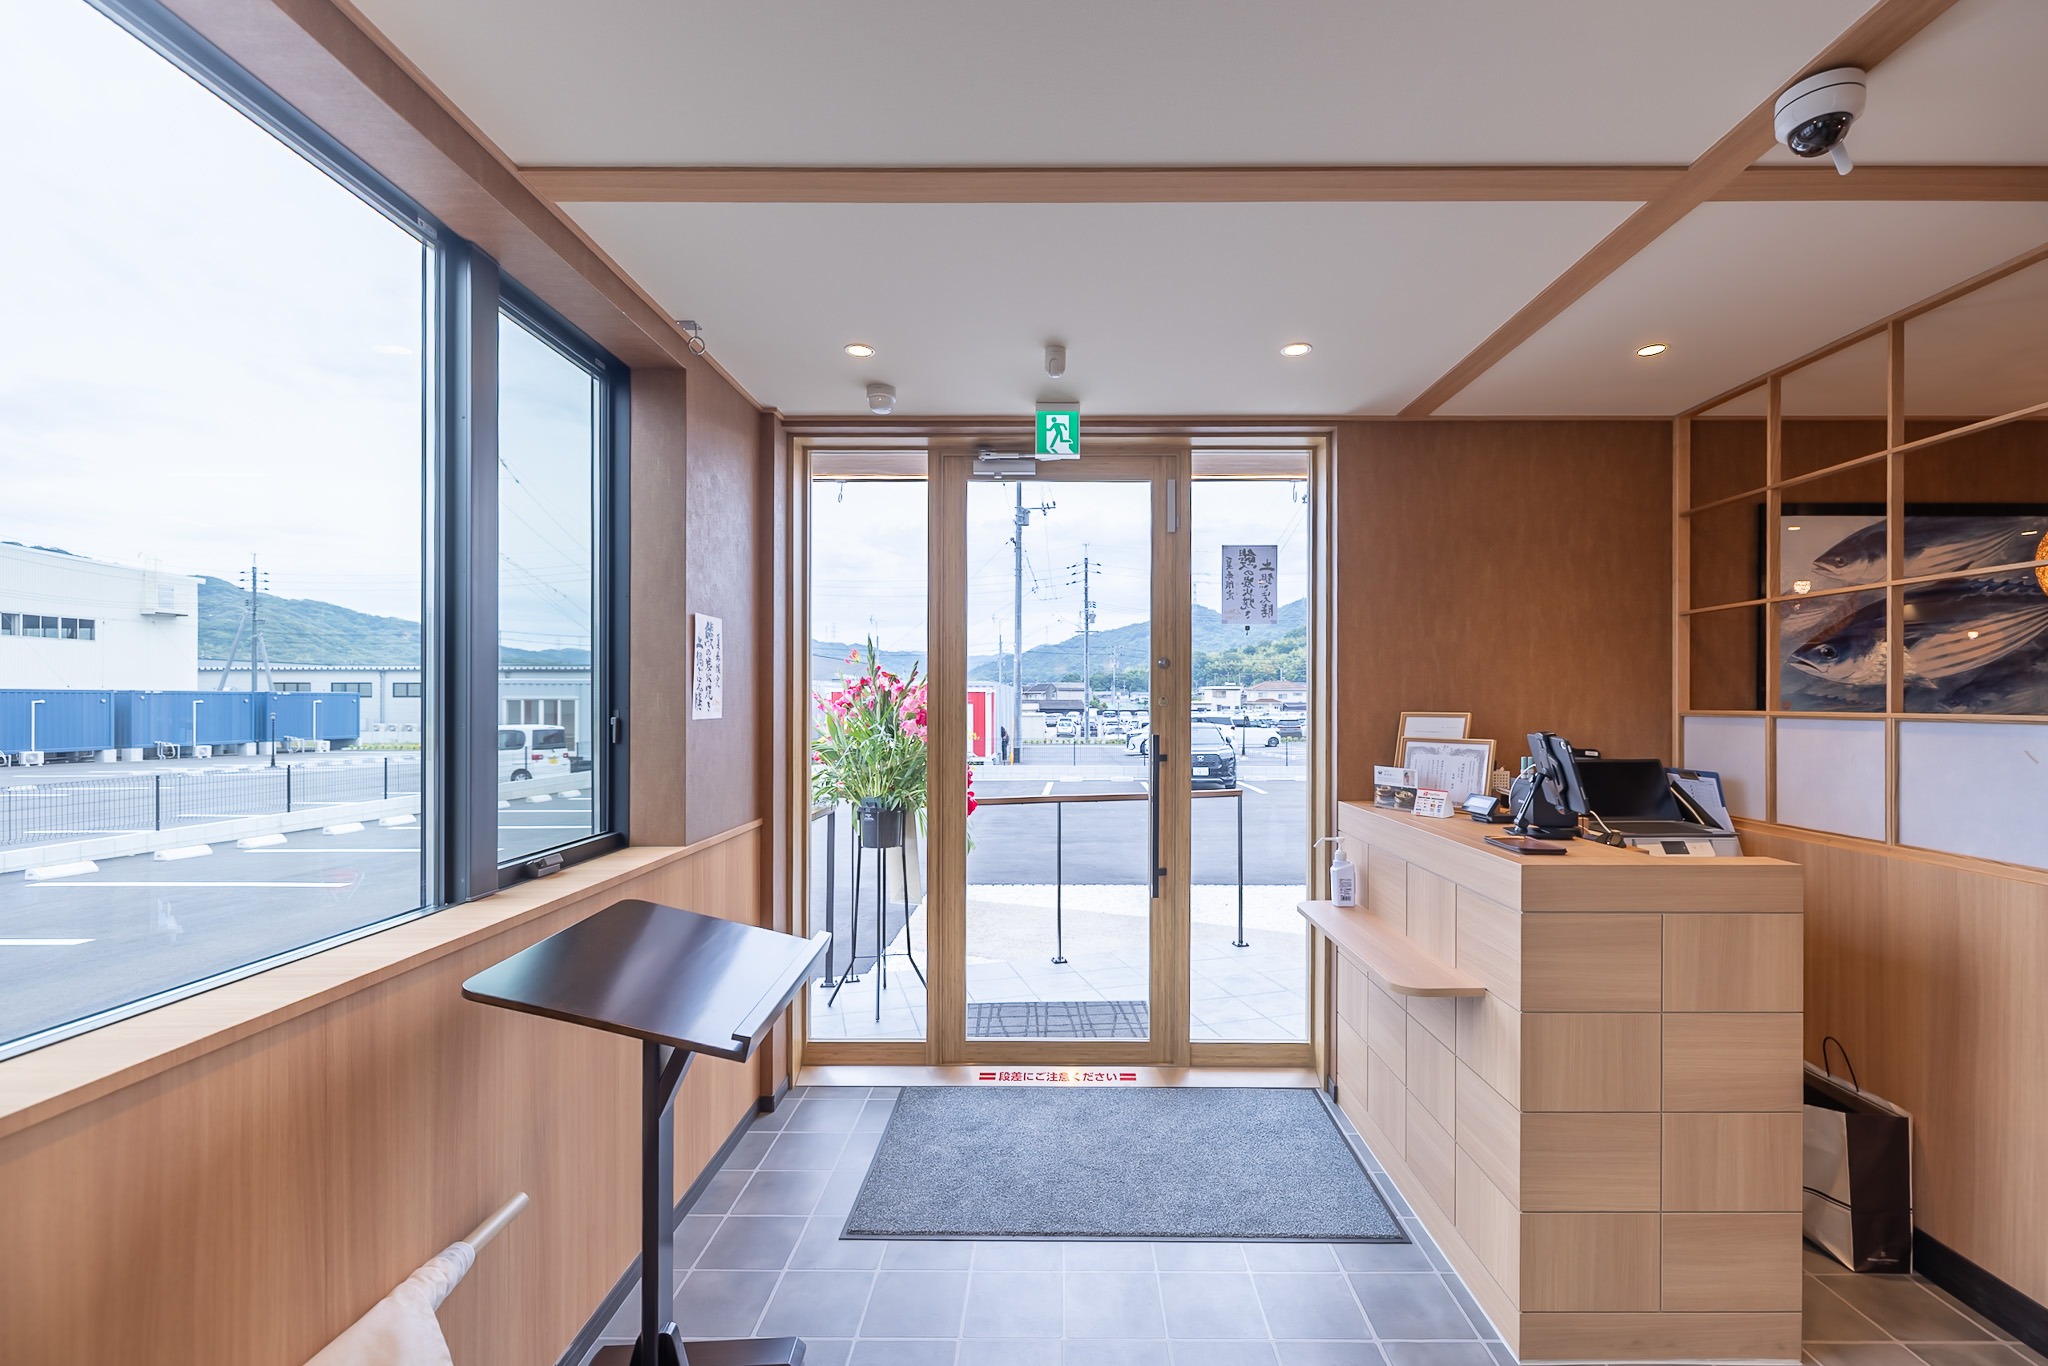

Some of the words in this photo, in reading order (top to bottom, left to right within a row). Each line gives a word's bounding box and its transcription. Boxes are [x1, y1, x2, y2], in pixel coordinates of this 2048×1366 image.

[998, 1071, 1118, 1082] 段差にご注意ください
